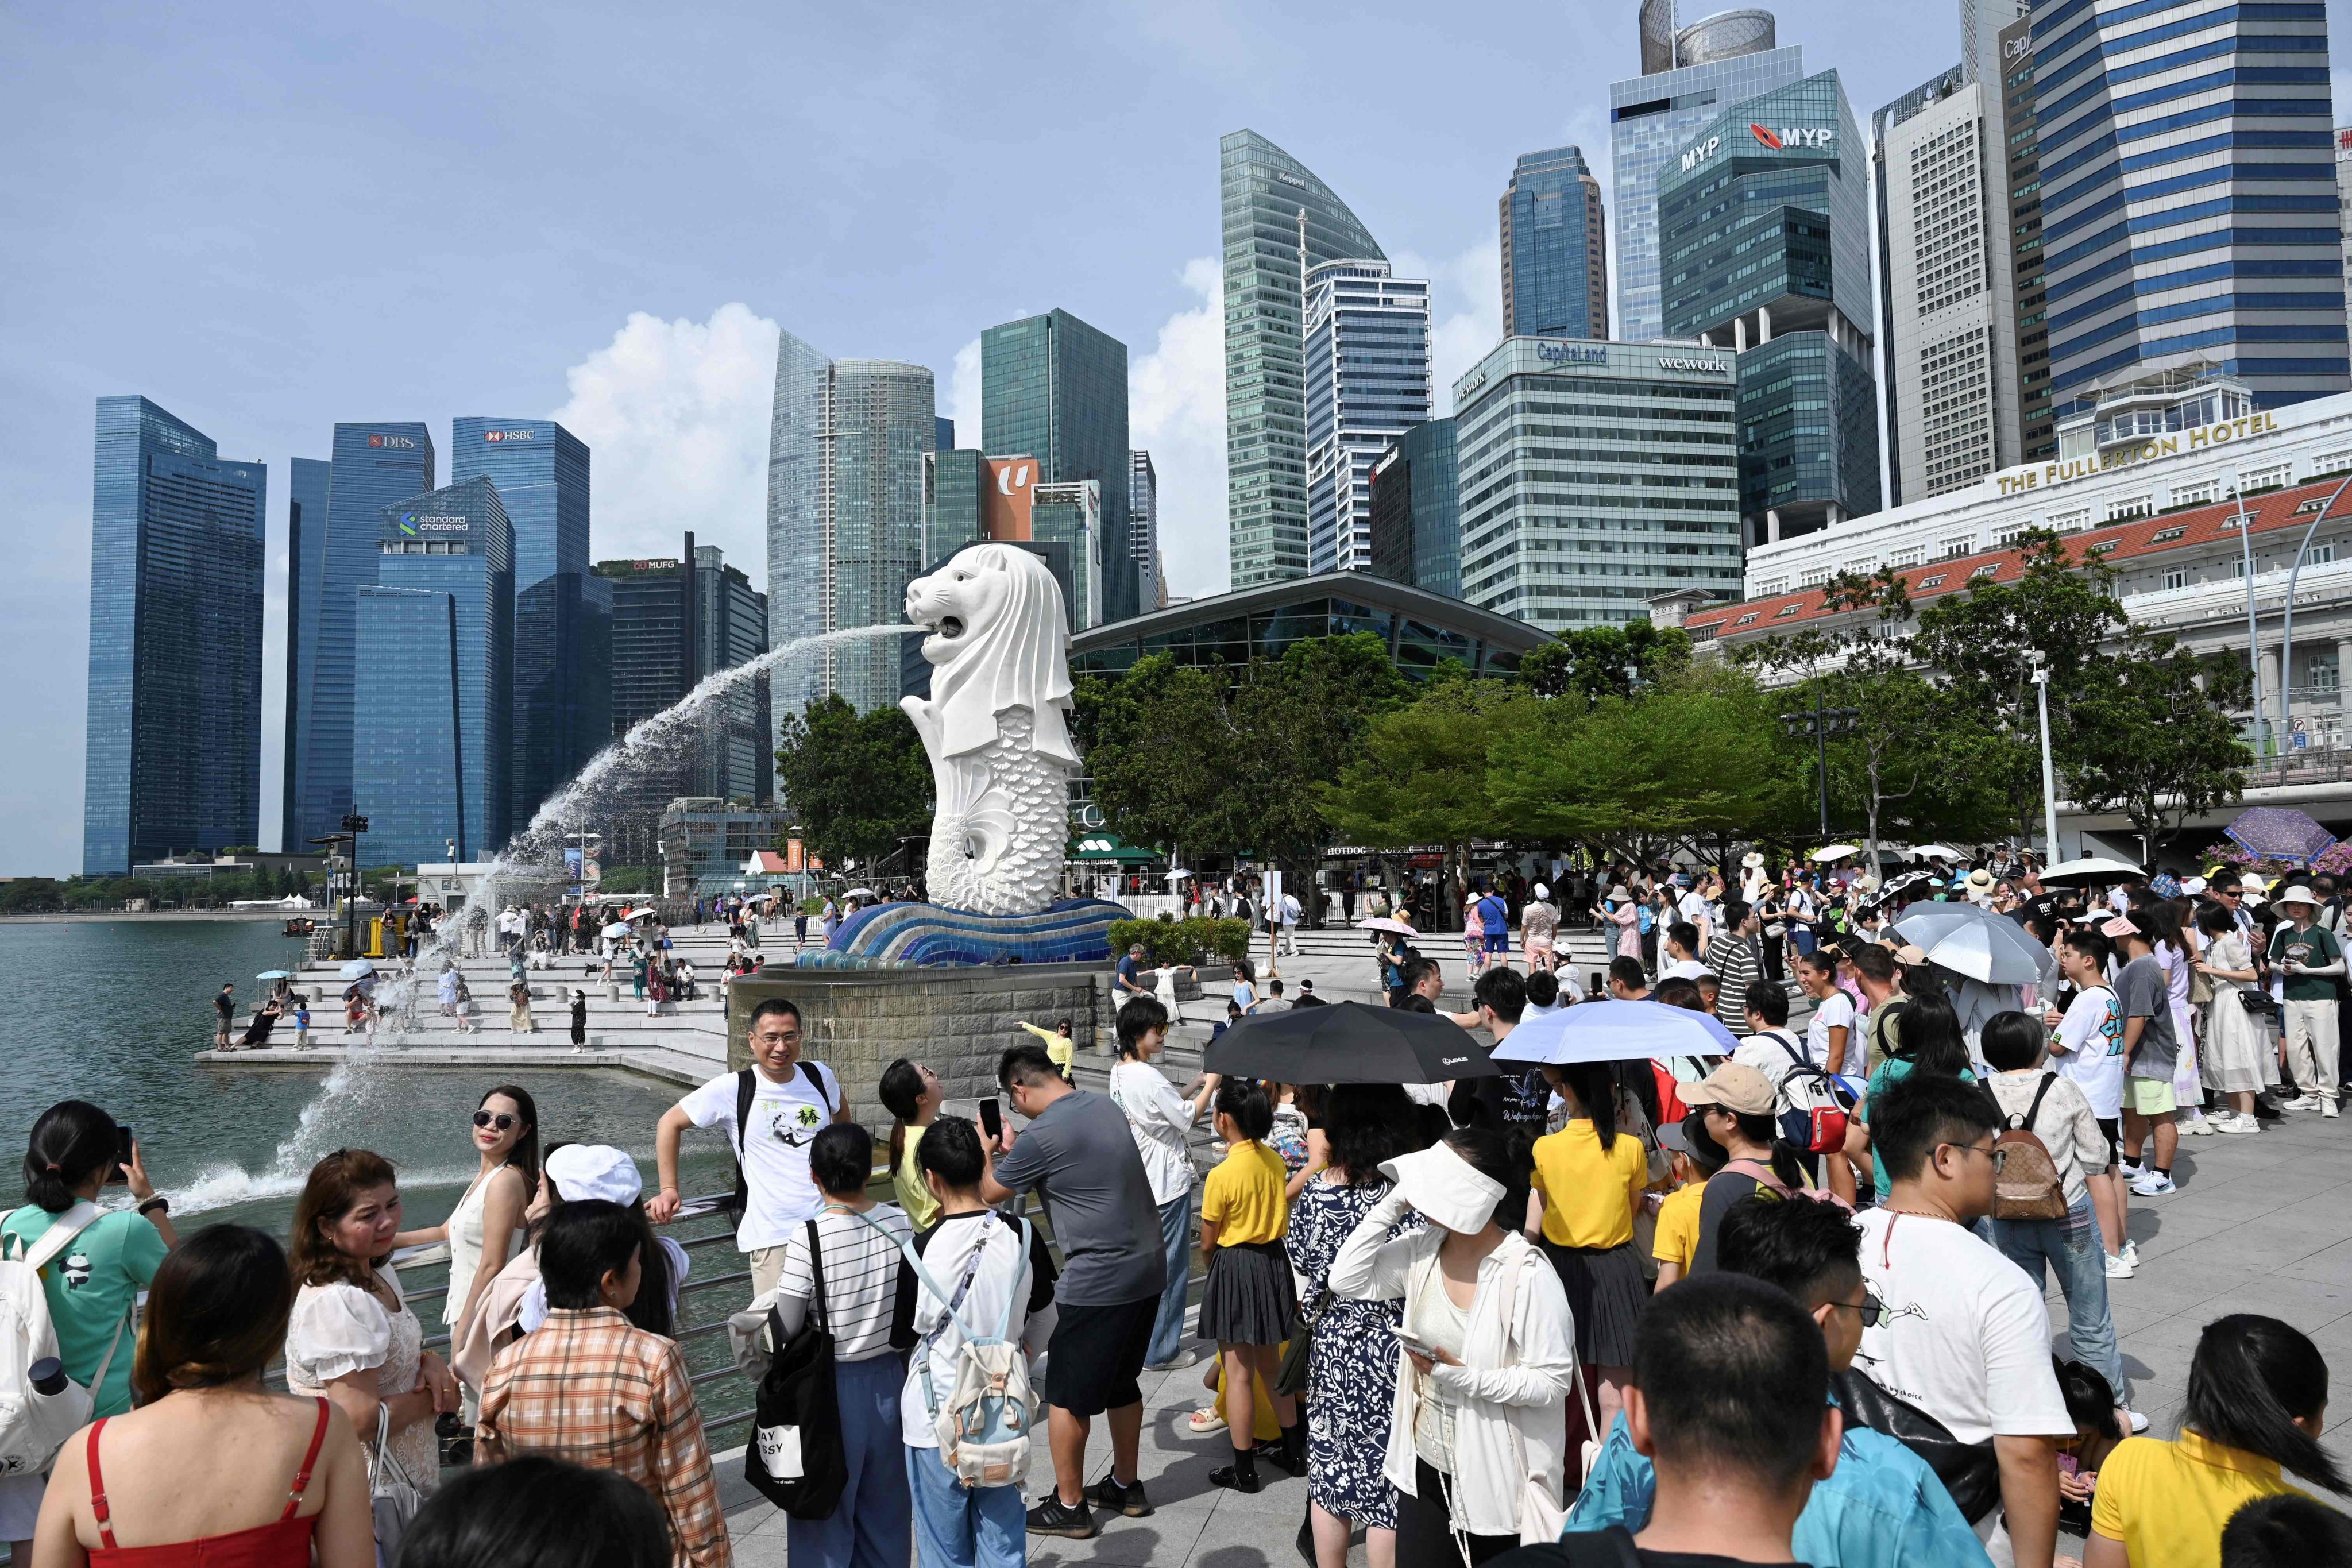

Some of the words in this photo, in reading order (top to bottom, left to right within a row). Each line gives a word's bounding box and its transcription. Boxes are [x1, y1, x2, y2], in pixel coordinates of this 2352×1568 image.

[1782, 128, 1832, 146] MYP
[1682, 136, 1719, 172] MYP
[1279, 172, 1305, 187] Keppel
[1538, 341, 1607, 364] CapitaLand
[1658, 354, 1727, 371] wework
[1456, 366, 1485, 402] wework
[384, 436, 415, 449] DBS
[504, 430, 535, 441] HSBC
[1997, 472, 2037, 495] THE
[2046, 435, 2177, 484] FULLERTON
[2190, 412, 2278, 449] HOTEL
[420, 516, 466, 524] standard
[420, 523, 468, 531] chartered
[1327, 847, 1366, 855] HOTDOG
[1890, 1385, 1898, 1397] by
[1900, 1389, 1924, 1401] choice
